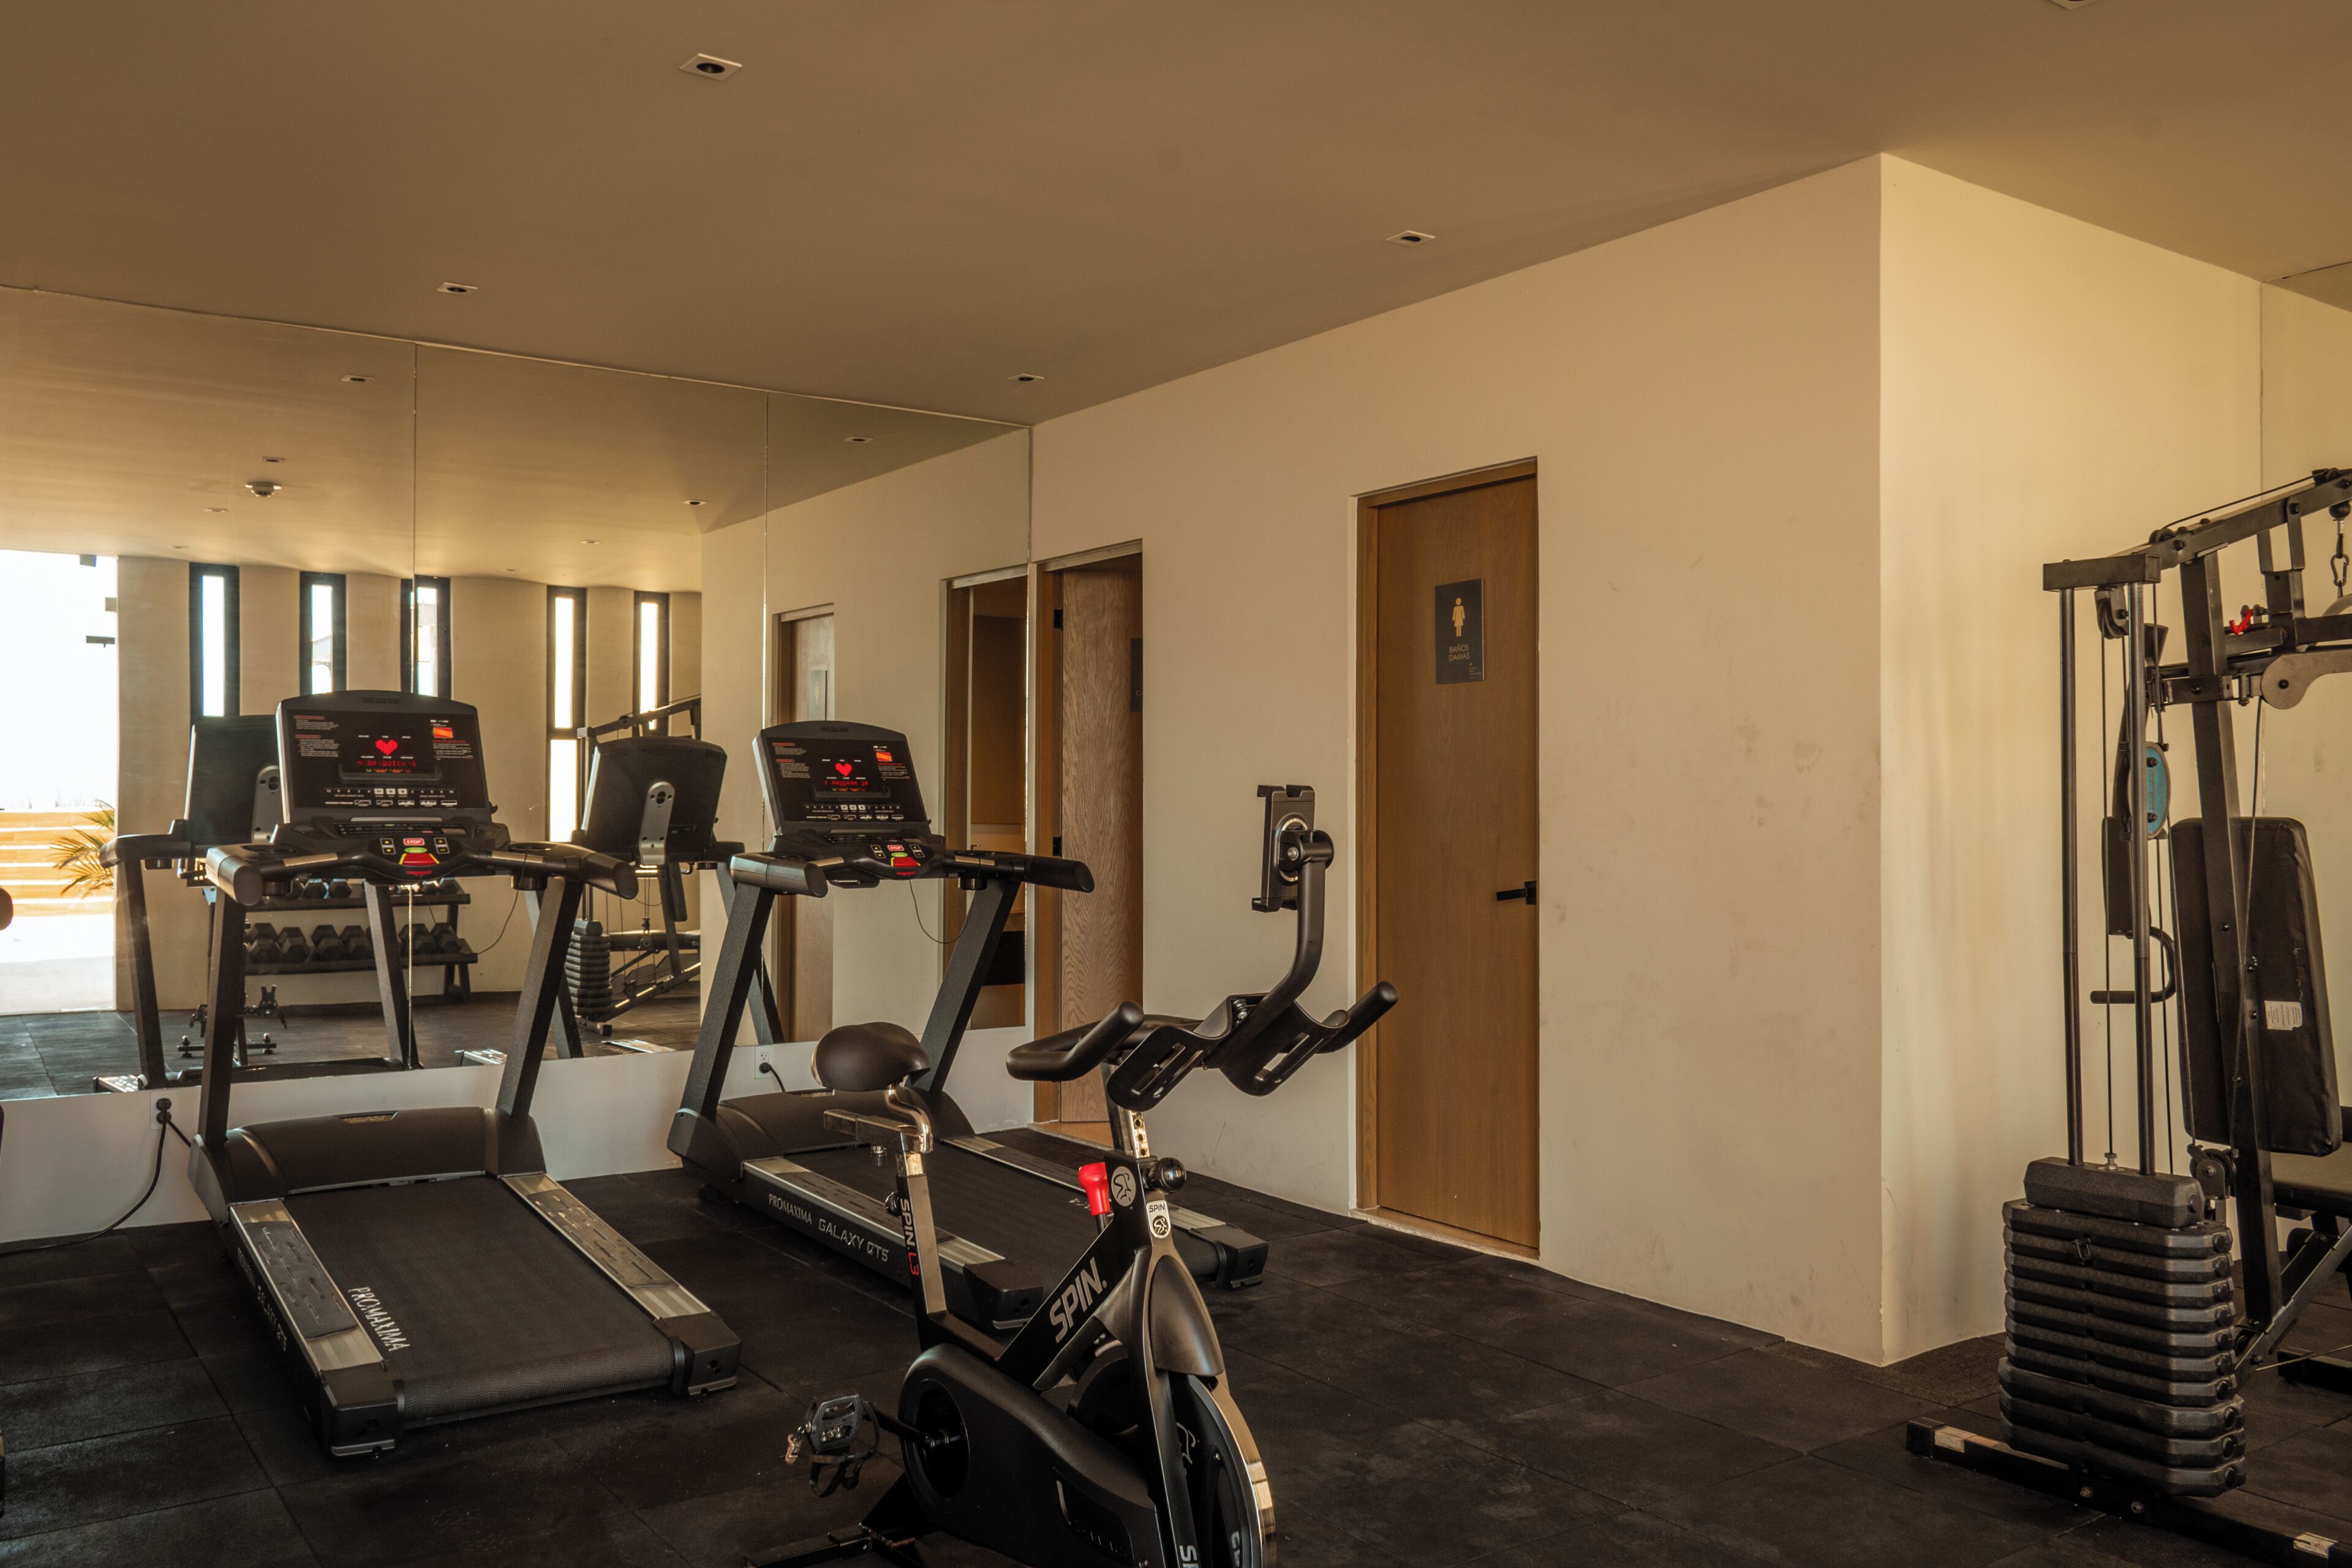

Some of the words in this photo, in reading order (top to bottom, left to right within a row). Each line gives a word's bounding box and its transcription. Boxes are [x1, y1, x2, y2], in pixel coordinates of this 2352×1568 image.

[1448, 652, 1470, 662] DAMAS
[1449, 644, 1470, 654] BAÑOS
[768, 1193, 813, 1225] PROMAXIMA
[818, 1218, 864, 1250] GALAXY
[900, 1198, 916, 1247] SPIN
[908, 1251, 920, 1276] L3
[1149, 1204, 1166, 1213] SPIN
[347, 1286, 410, 1352] PROMAXIMA
[1049, 1256, 1104, 1343] SPIN
